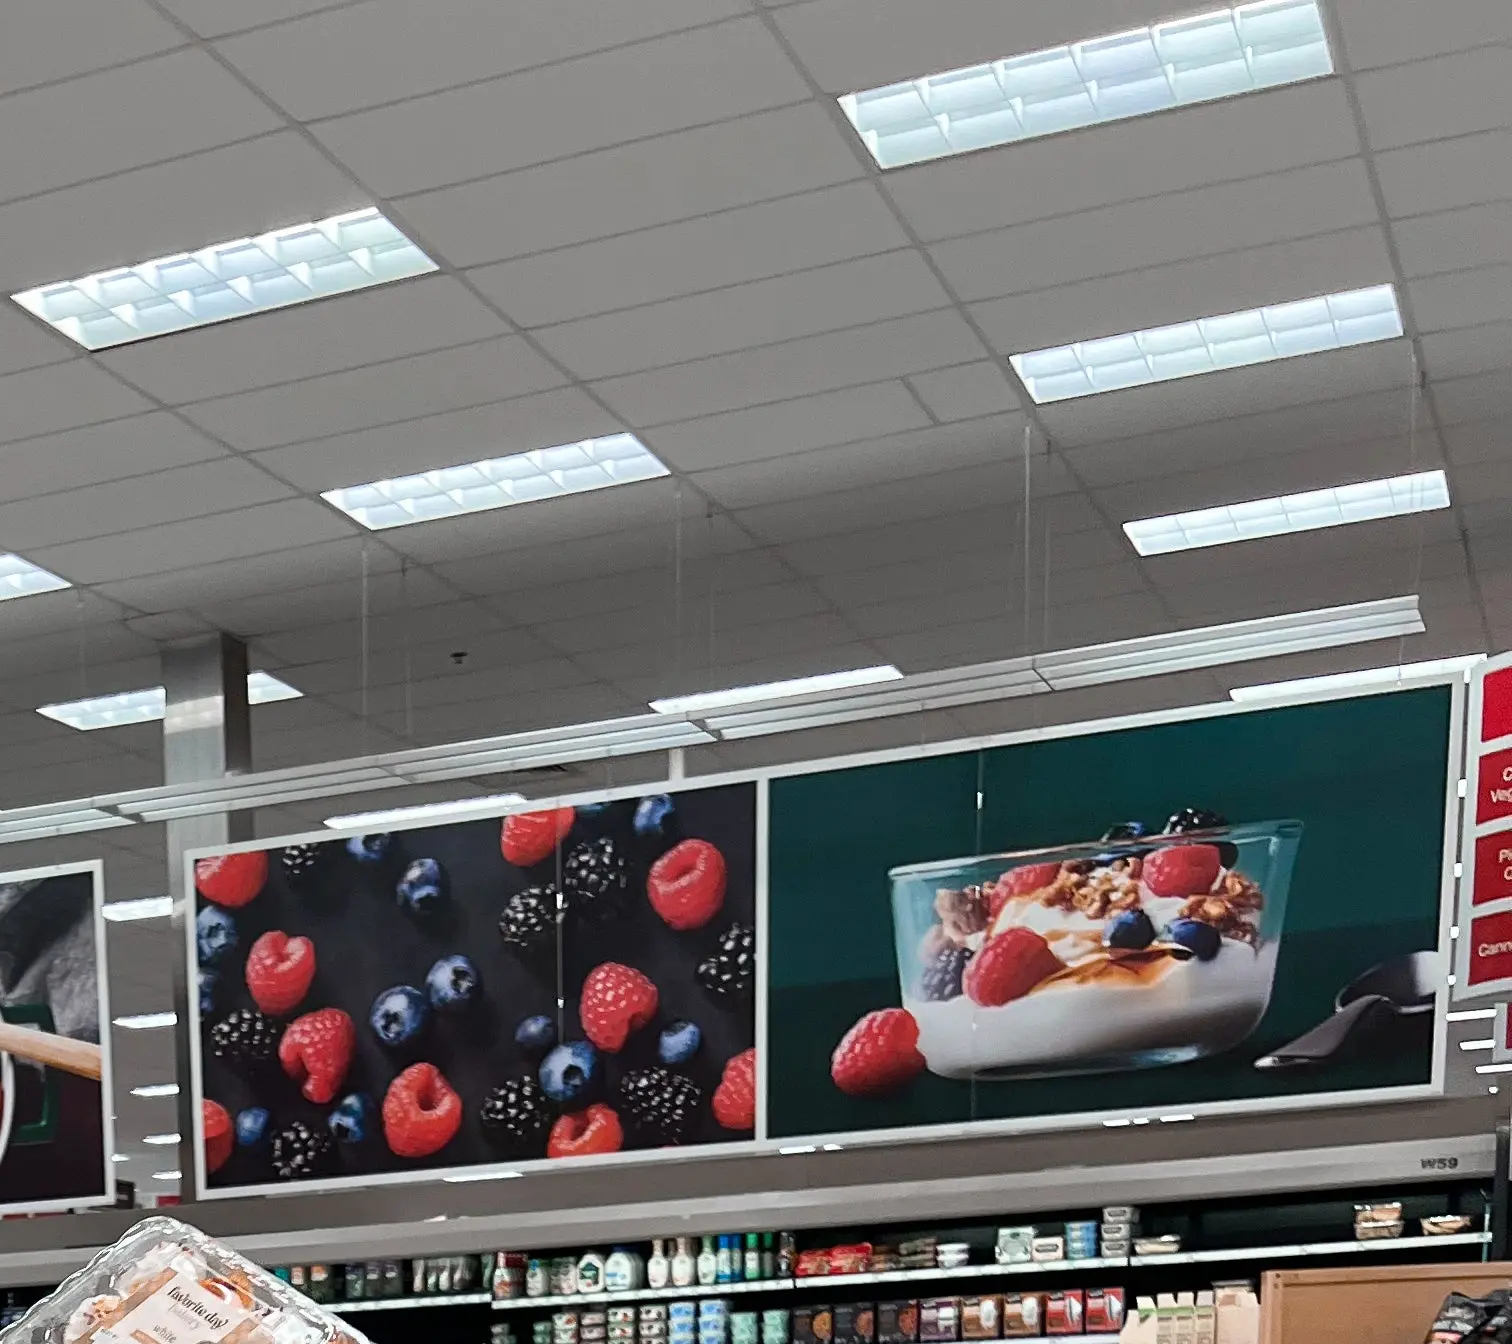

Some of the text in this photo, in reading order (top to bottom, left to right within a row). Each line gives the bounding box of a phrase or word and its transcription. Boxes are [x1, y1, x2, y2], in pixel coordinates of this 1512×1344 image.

[1420, 1156, 1459, 1170] W59
[167, 1286, 229, 1330] favorite day
